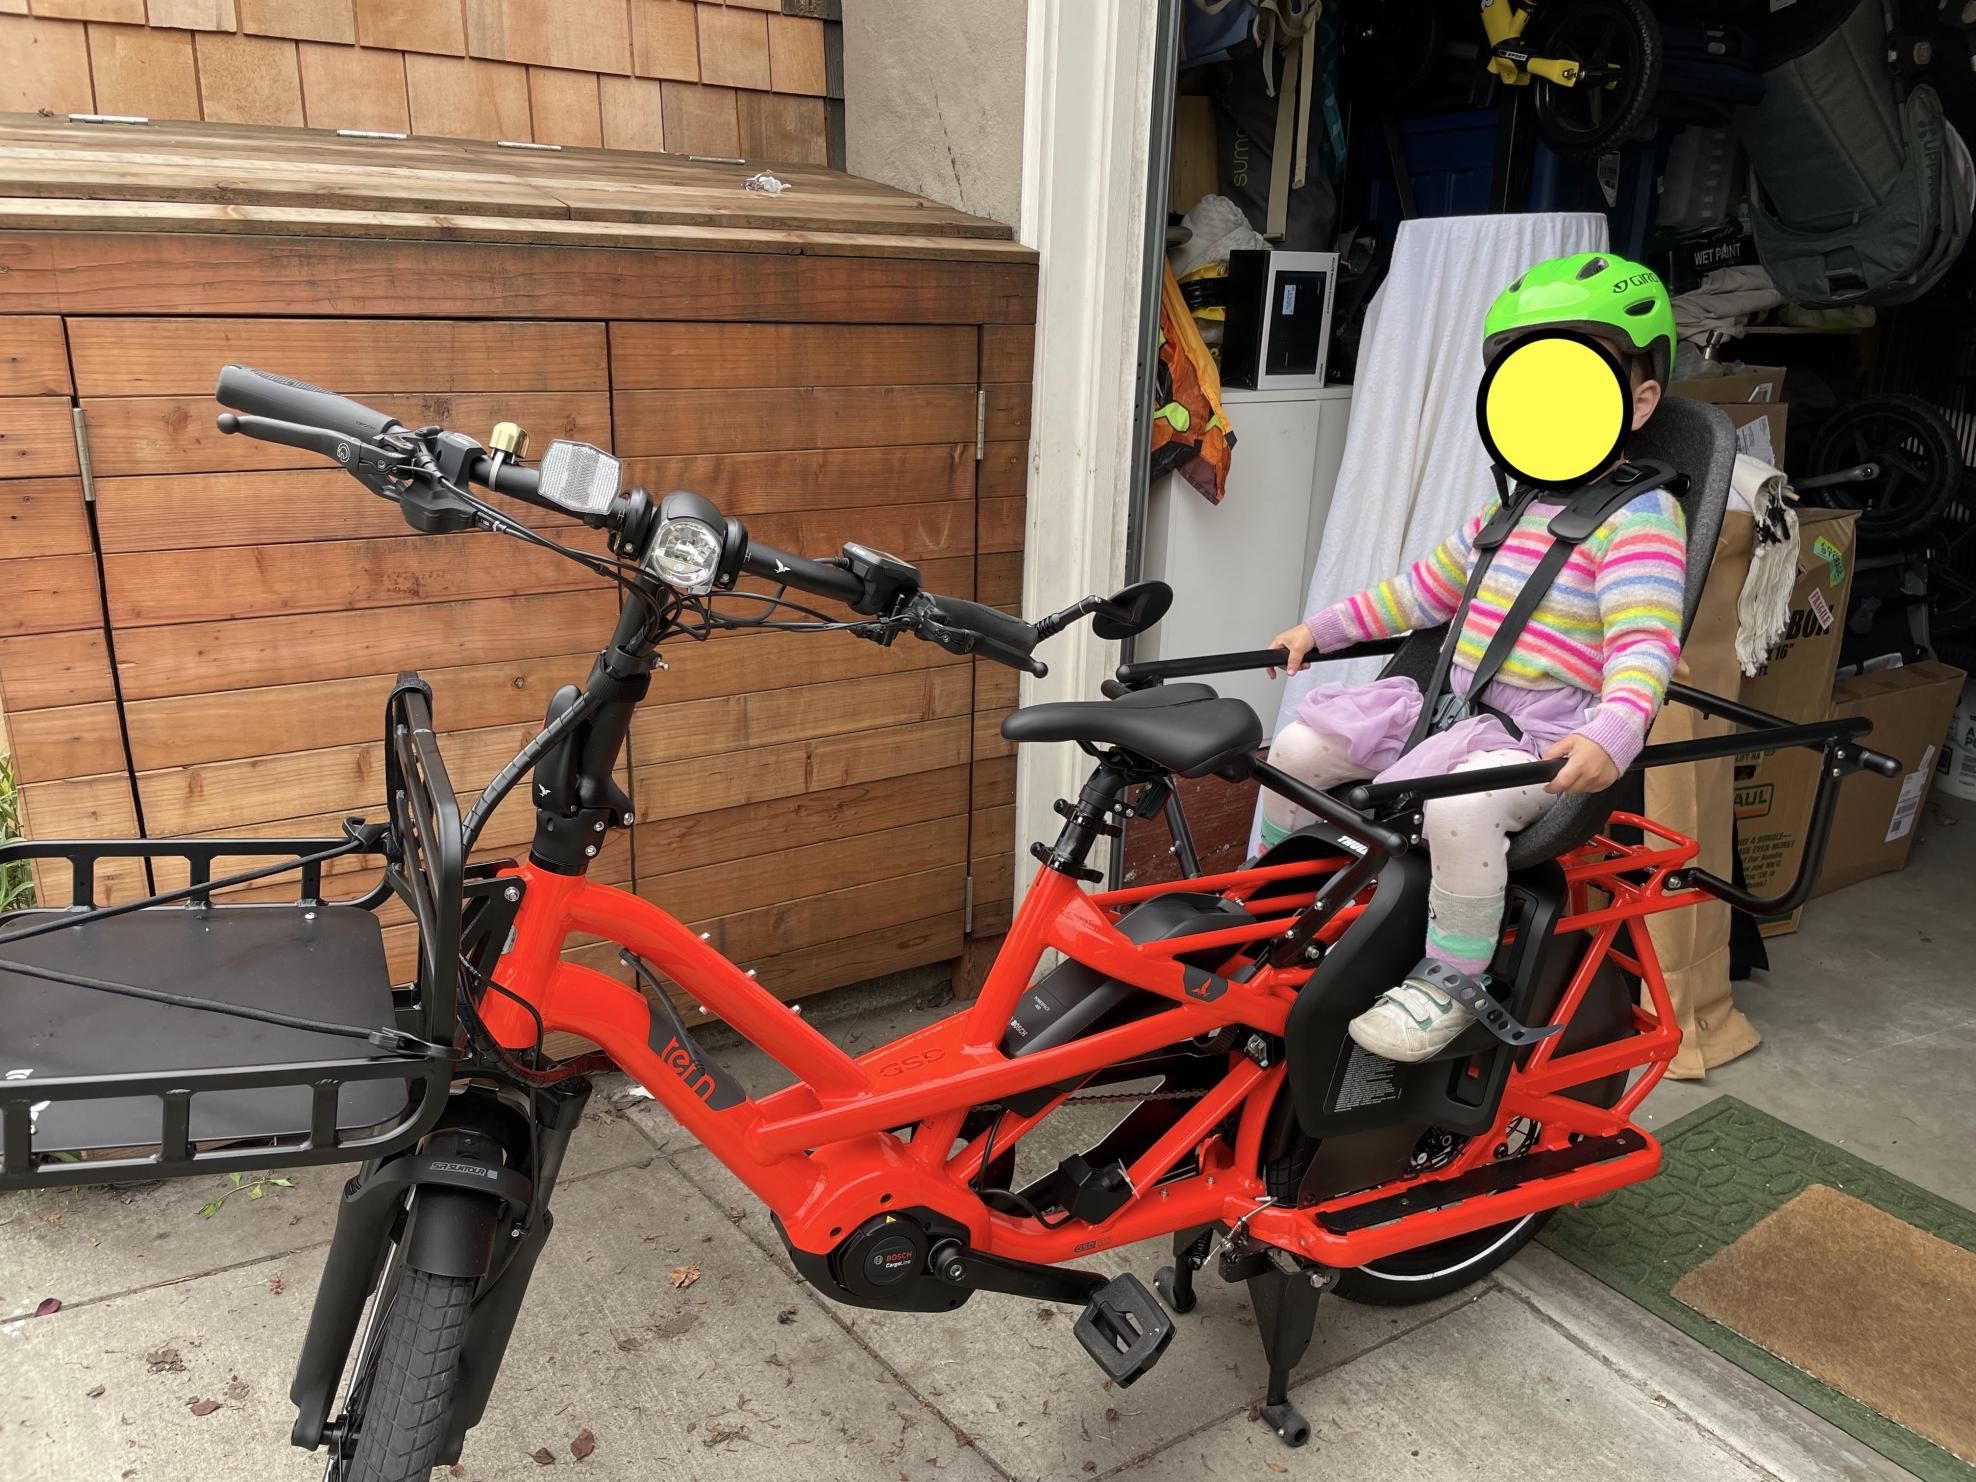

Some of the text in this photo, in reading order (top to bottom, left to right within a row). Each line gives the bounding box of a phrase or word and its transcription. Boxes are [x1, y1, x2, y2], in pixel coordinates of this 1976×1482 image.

[1694, 243, 1742, 266] WET PAINT
[1629, 272, 1659, 288] GIRO
[1810, 591, 1832, 626] FRAGILE
[1734, 789, 1768, 808] AUL
[1010, 1019, 1029, 1037] BOSCH
[879, 1047, 947, 1078] GSD
[448, 1163, 487, 1177] SUNTOUR
[886, 1250, 913, 1262] BOSCH
